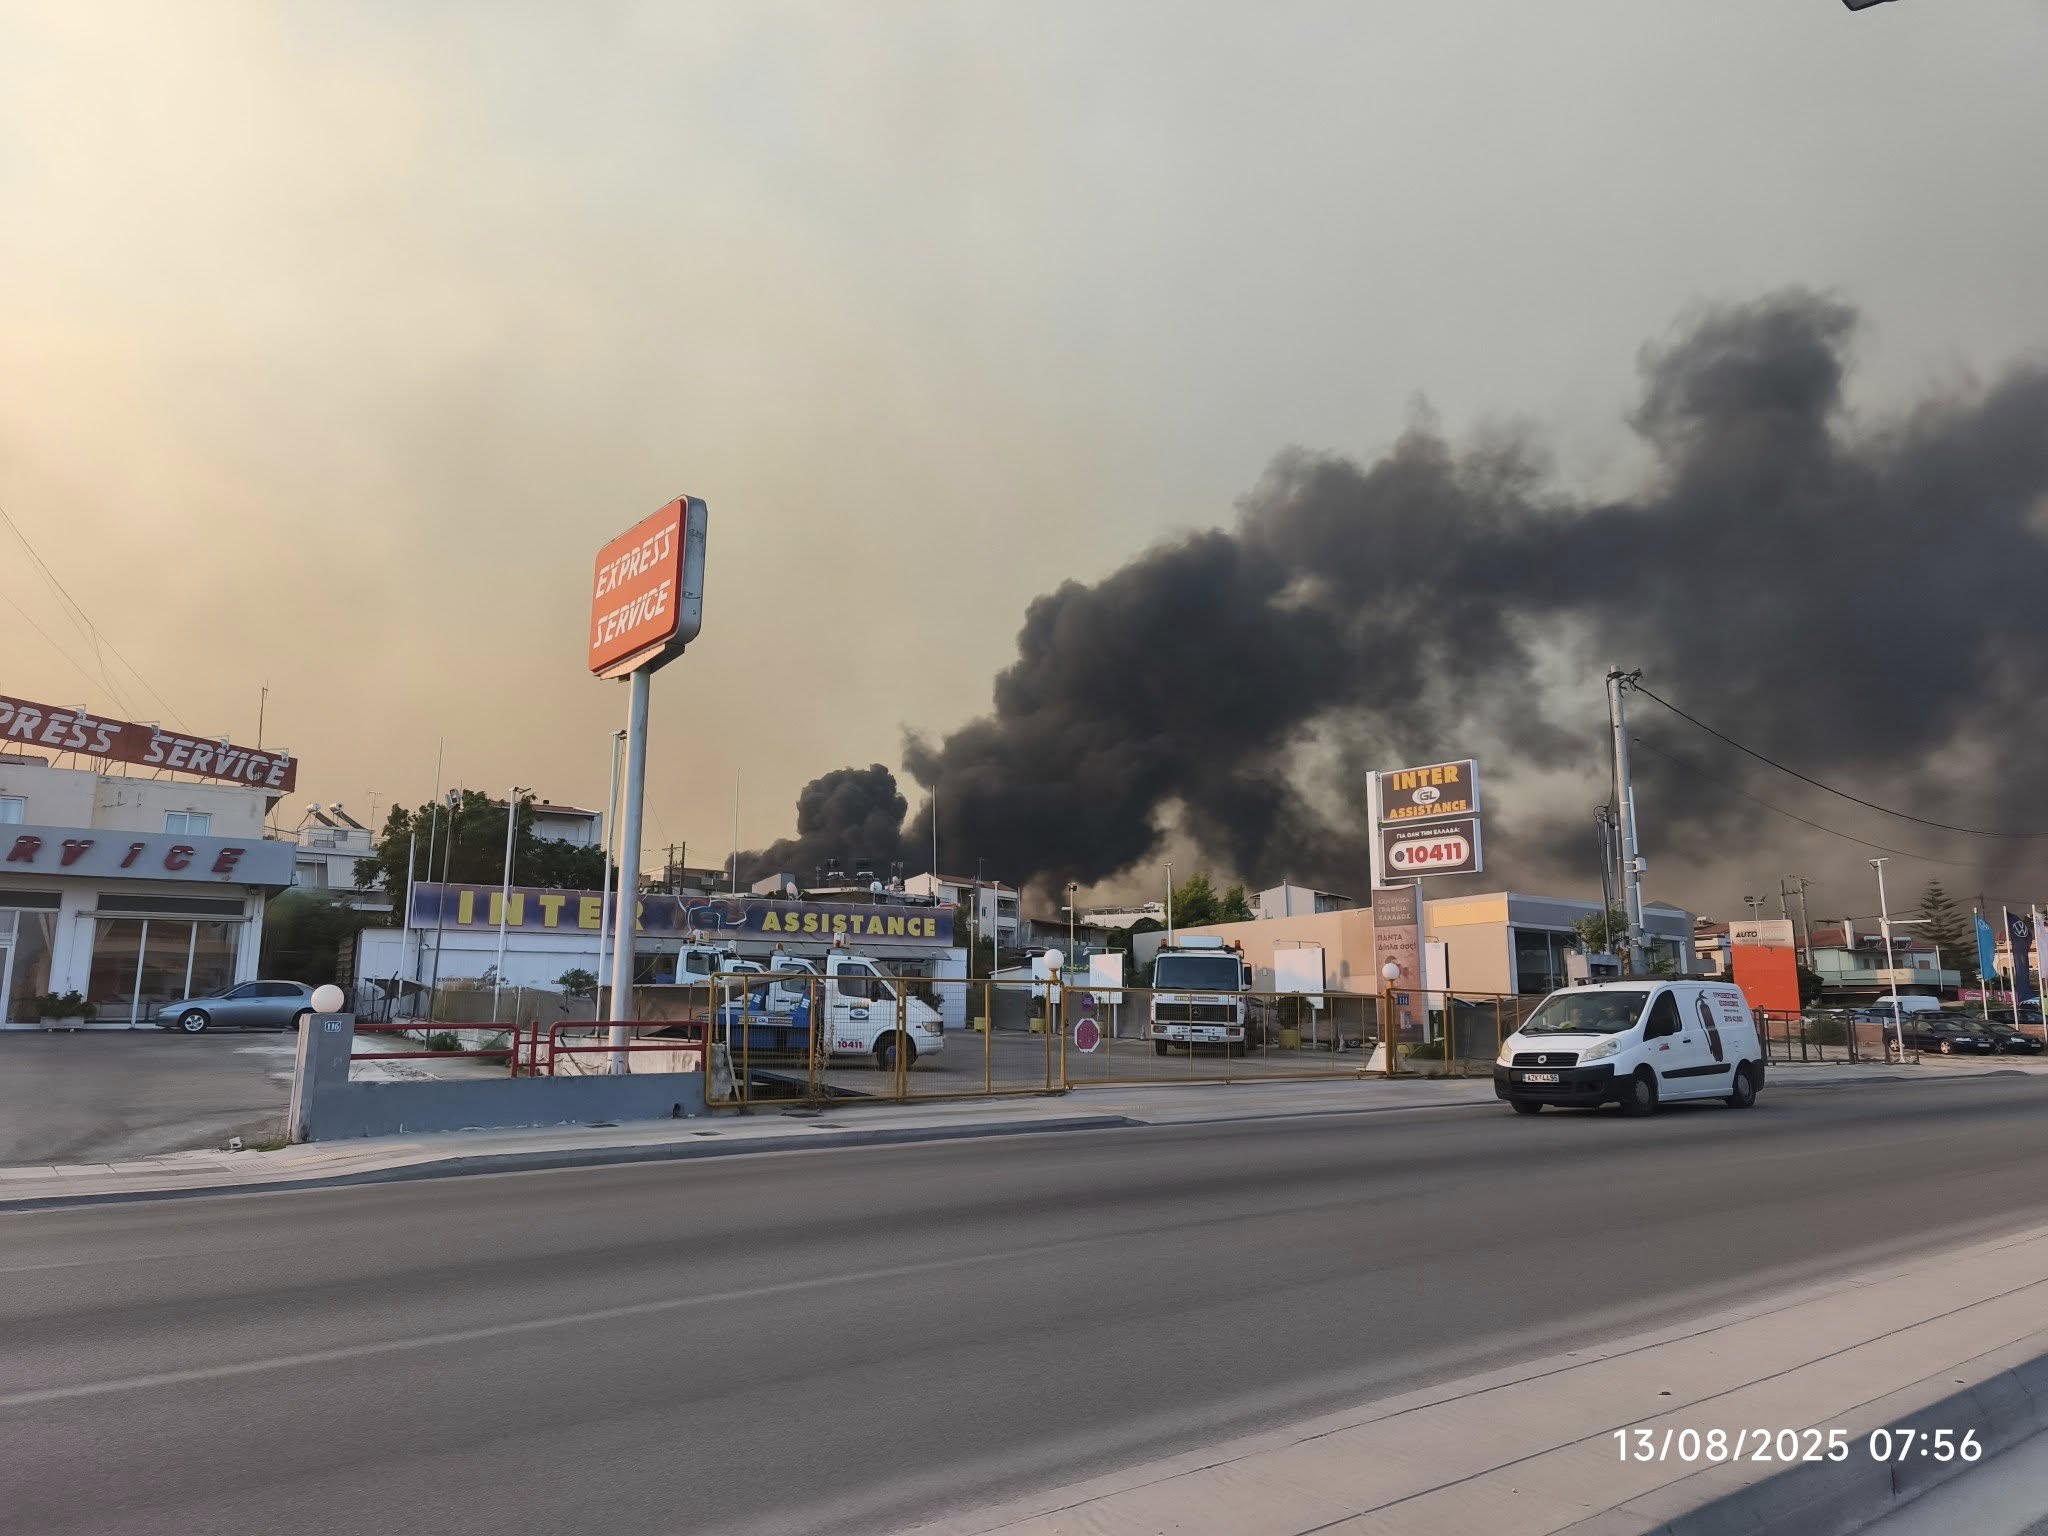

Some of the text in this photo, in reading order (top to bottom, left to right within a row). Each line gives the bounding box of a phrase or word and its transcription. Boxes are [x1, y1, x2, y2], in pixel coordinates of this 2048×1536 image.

[595, 522, 677, 600] EXPRESS
[593, 579, 671, 649] SERVICE
[144, 735, 290, 787] SERVICE
[1393, 765, 1459, 791] INTER
[1389, 799, 1467, 819] ASSISTANCE
[1405, 843, 1462, 864] 10411
[762, 911, 936, 937] ASSISTANCE
[326, 1022, 340, 1031] 116
[837, 1040, 863, 1049] 10411
